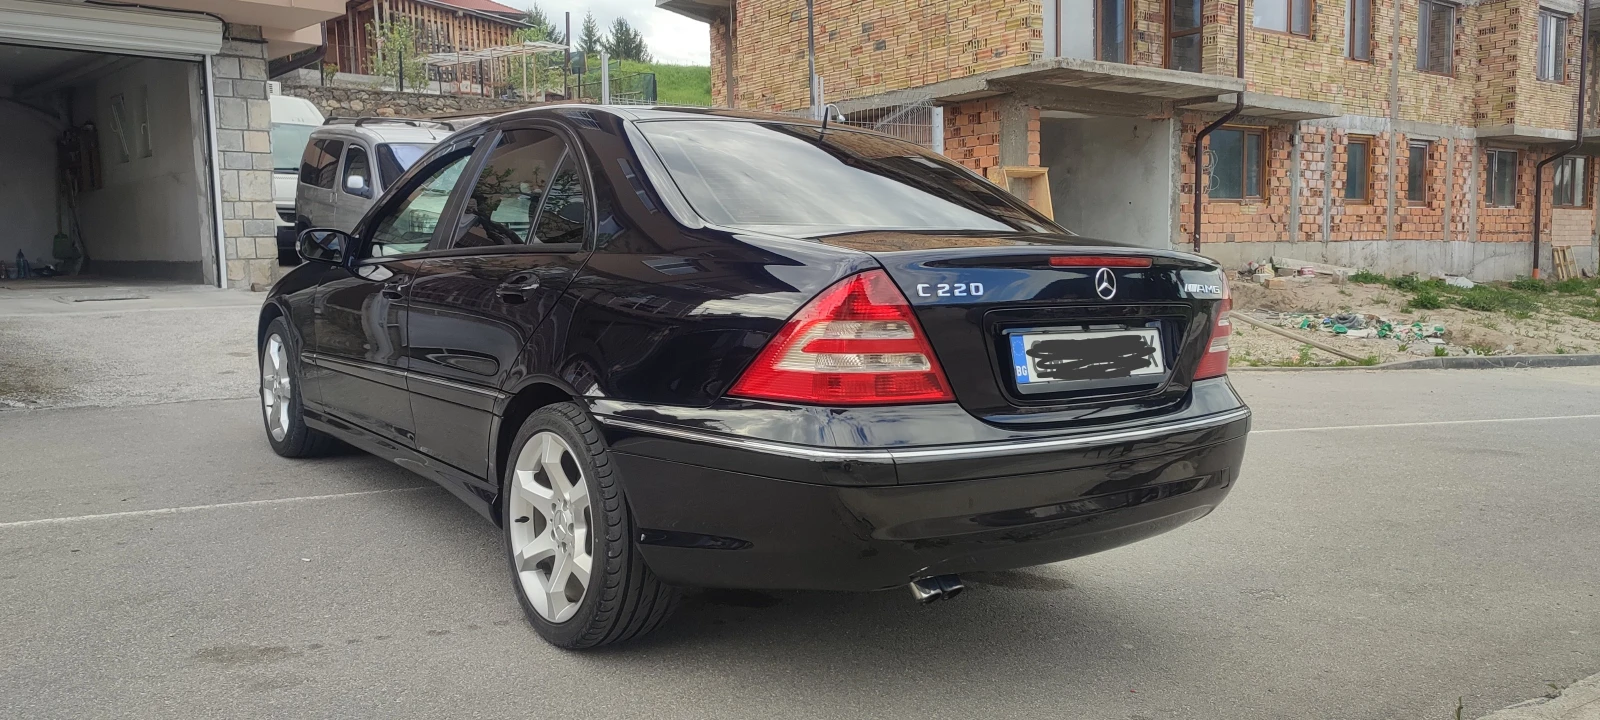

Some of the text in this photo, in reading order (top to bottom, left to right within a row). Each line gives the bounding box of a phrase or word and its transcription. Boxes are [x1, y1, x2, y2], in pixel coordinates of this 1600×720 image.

[916, 282, 984, 297] C 220
[1196, 284, 1221, 294] AMG
[1015, 365, 1028, 377] BG
